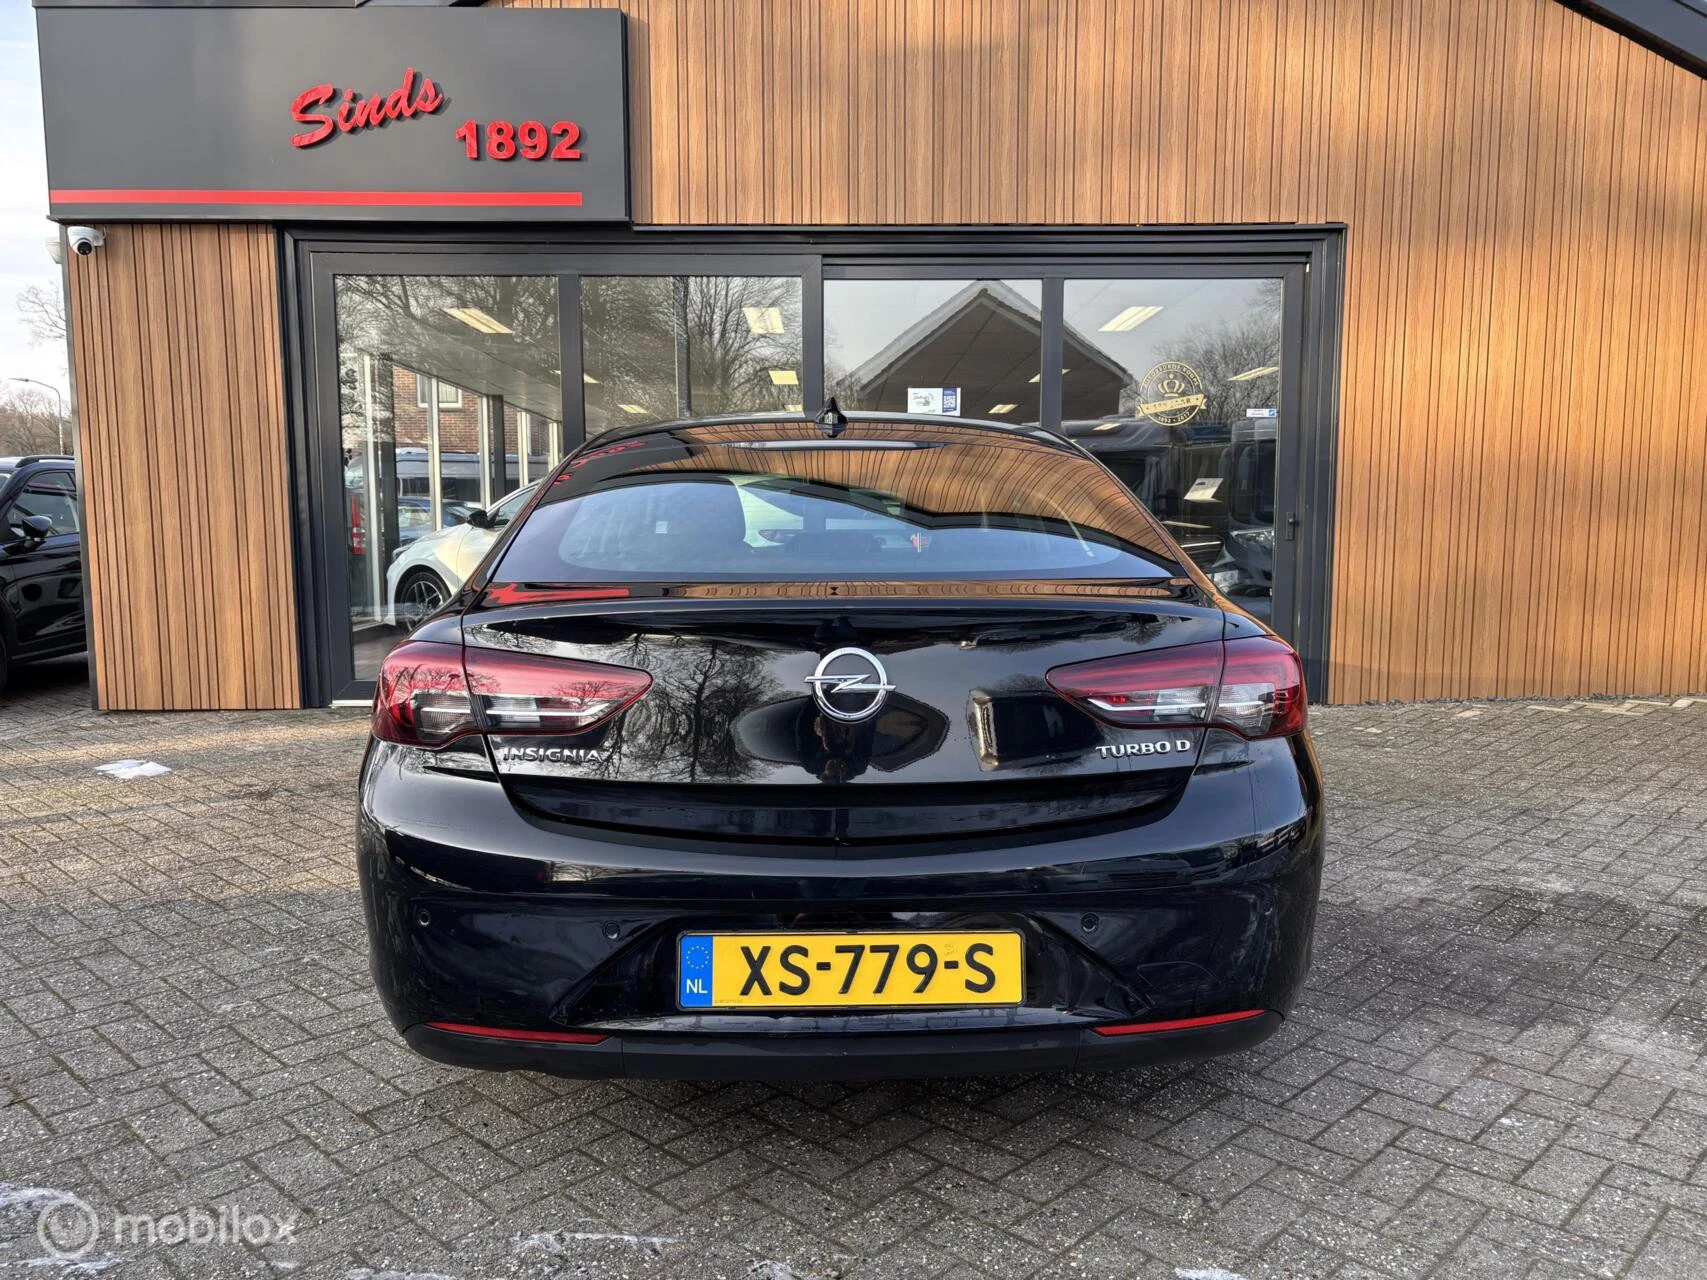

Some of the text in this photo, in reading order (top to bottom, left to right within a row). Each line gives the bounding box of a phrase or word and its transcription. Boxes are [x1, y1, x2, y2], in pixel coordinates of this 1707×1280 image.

[290, 66, 444, 148] Sinds
[455, 119, 582, 161] 1892
[503, 747, 603, 763] INSIGNIA
[1095, 739, 1191, 760] TURBO D
[739, 942, 997, 996] XS-779-S
[686, 978, 708, 994] NL
